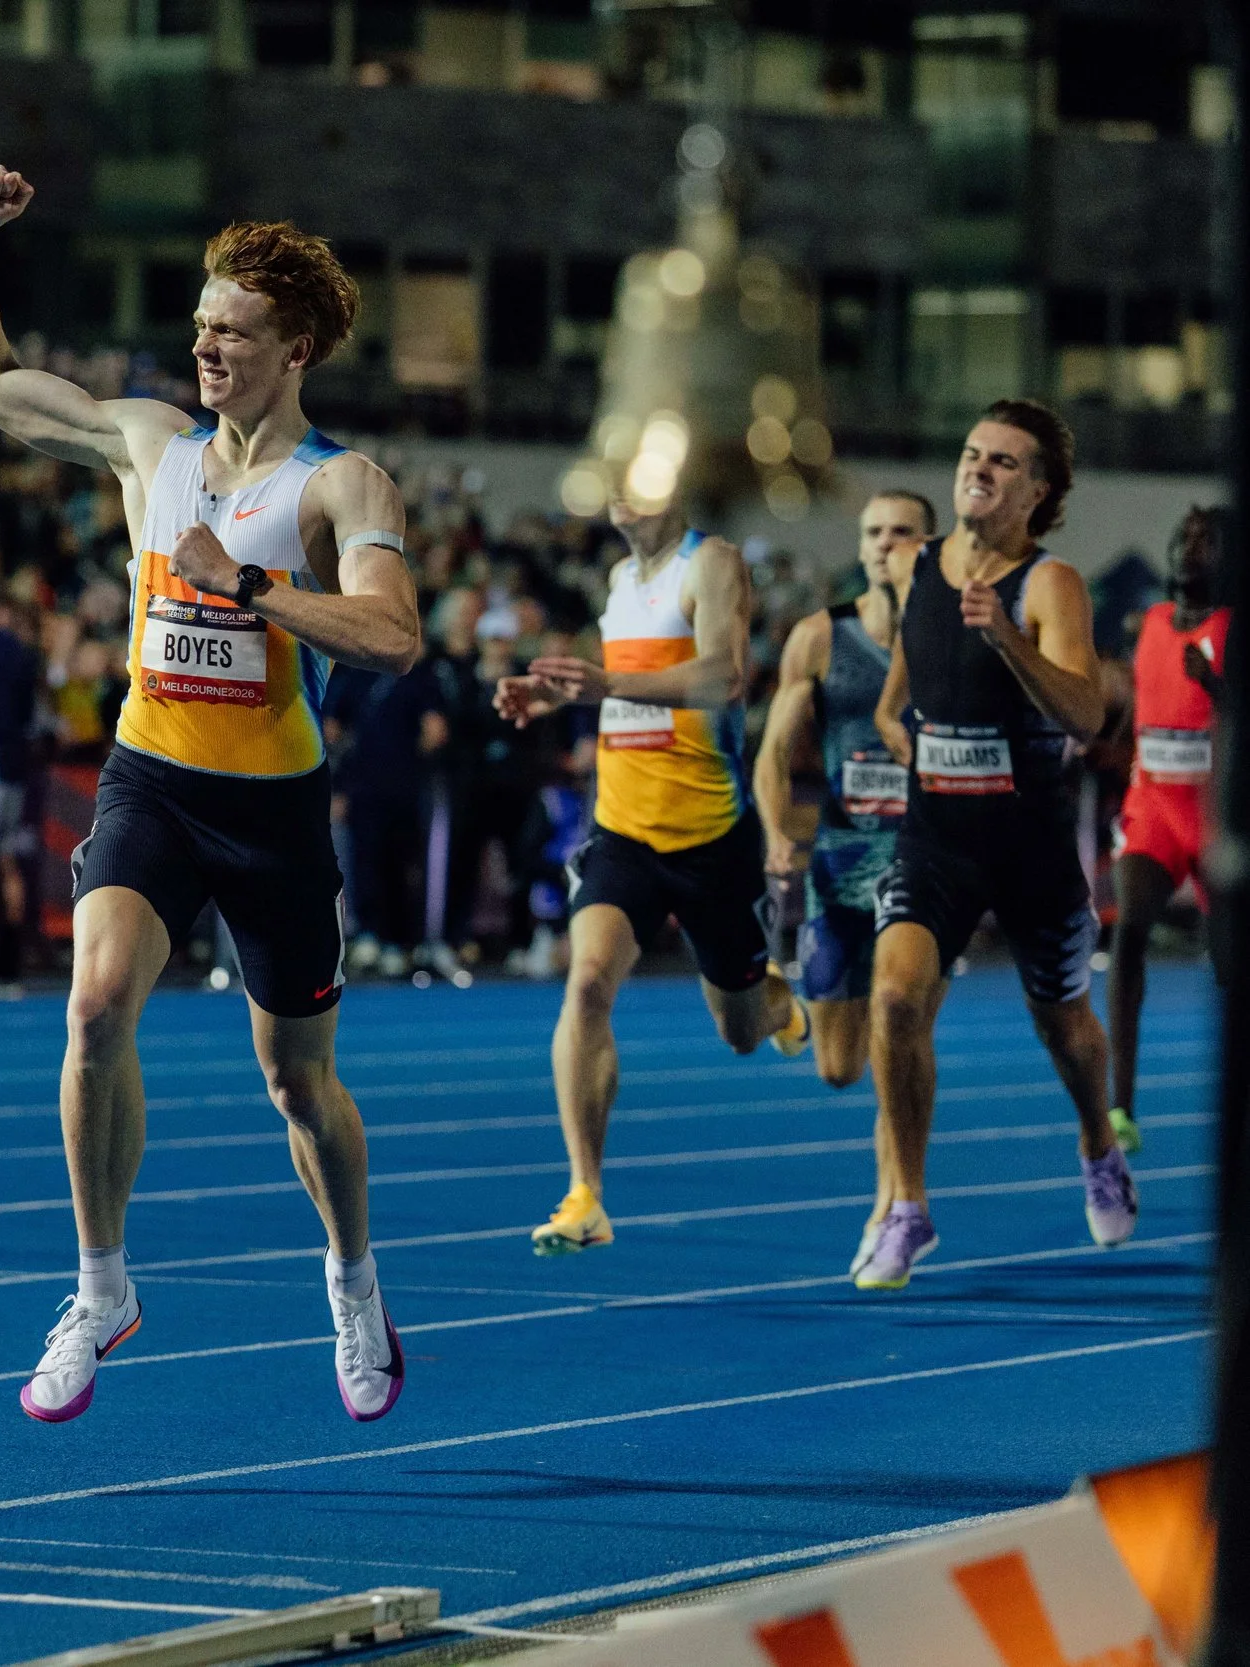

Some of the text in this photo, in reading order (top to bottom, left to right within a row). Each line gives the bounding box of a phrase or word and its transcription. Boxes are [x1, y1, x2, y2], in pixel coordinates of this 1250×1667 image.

[166, 610, 188, 621] SERIES
[201, 610, 257, 622] MELBOURNE
[164, 633, 233, 668] BOYES
[161, 680, 255, 699] MELBOURNE2026
[927, 745, 1001, 768] WILLIAMS
